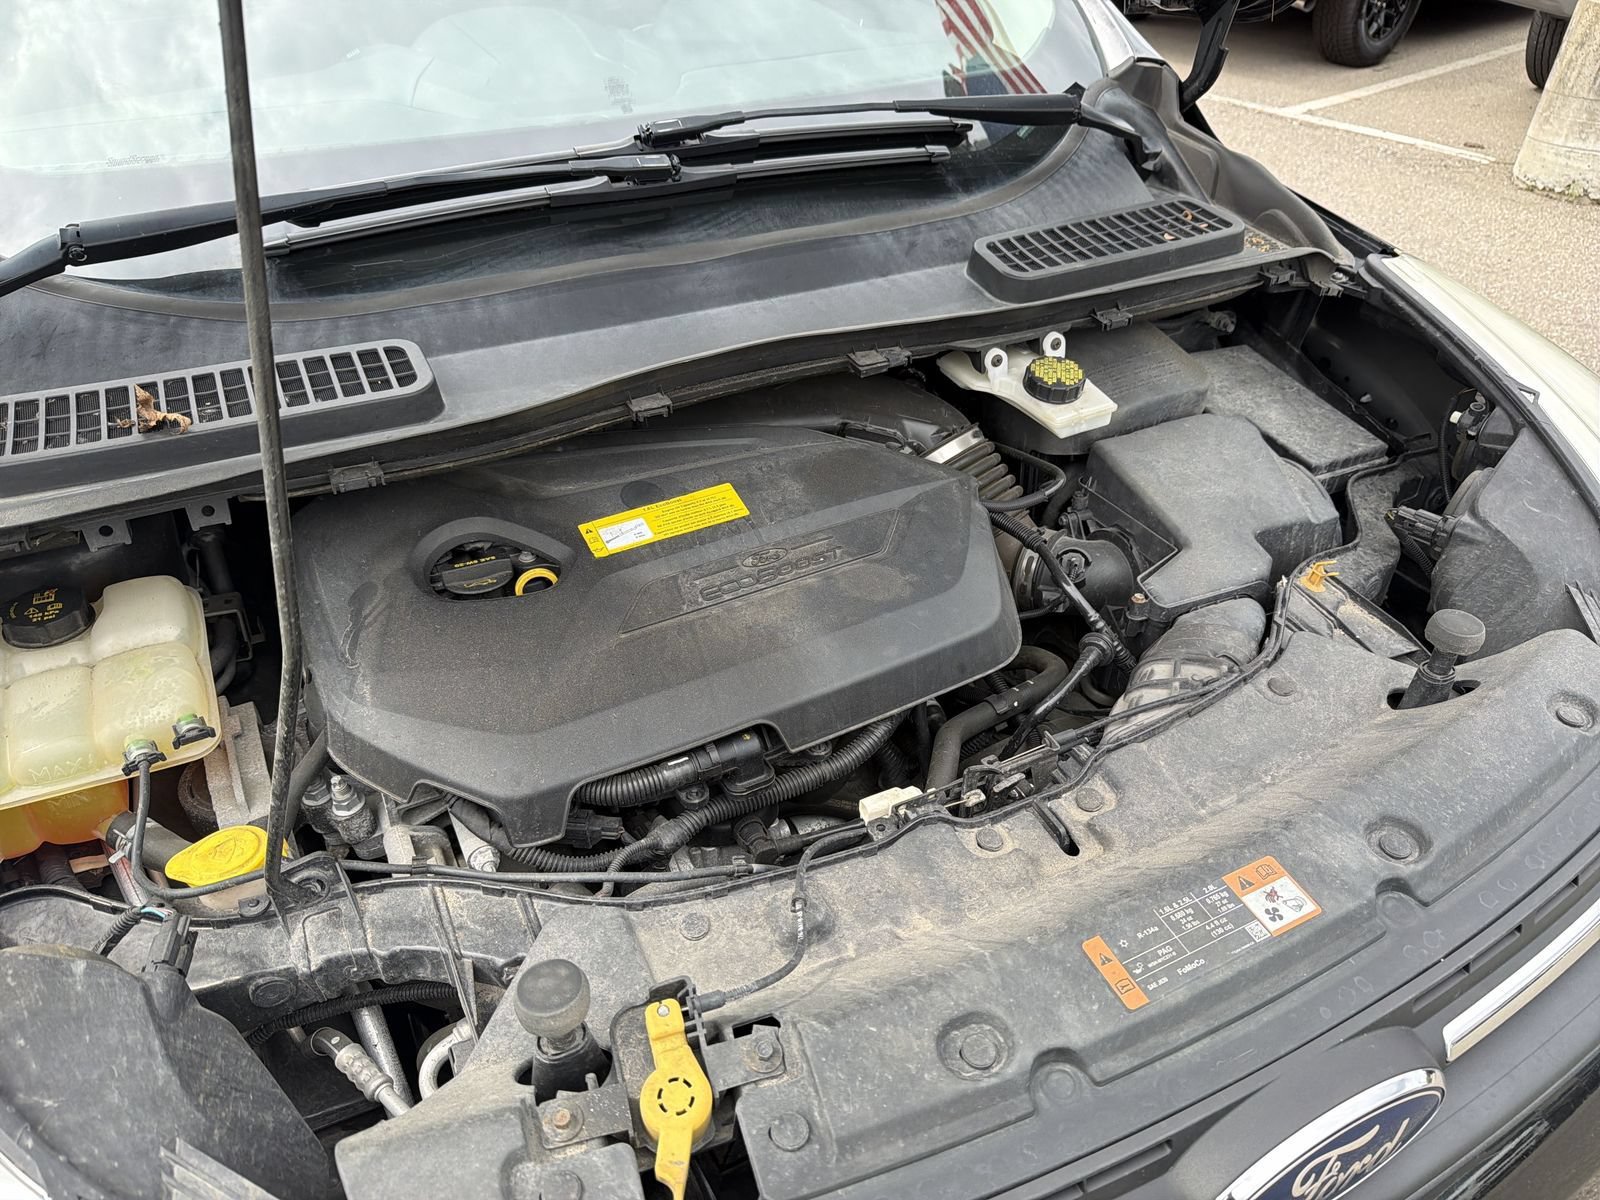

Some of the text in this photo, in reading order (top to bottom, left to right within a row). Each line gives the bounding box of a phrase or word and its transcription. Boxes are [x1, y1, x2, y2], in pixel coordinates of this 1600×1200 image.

[28, 757, 82, 785] MAX
[1202, 884, 1218, 894] 2.0L
[1136, 926, 1160, 939] R-134a
[1156, 945, 1174, 957] PAG
[1176, 958, 1206, 976] FoMoCo
[1291, 1117, 1410, 1200] Ford
